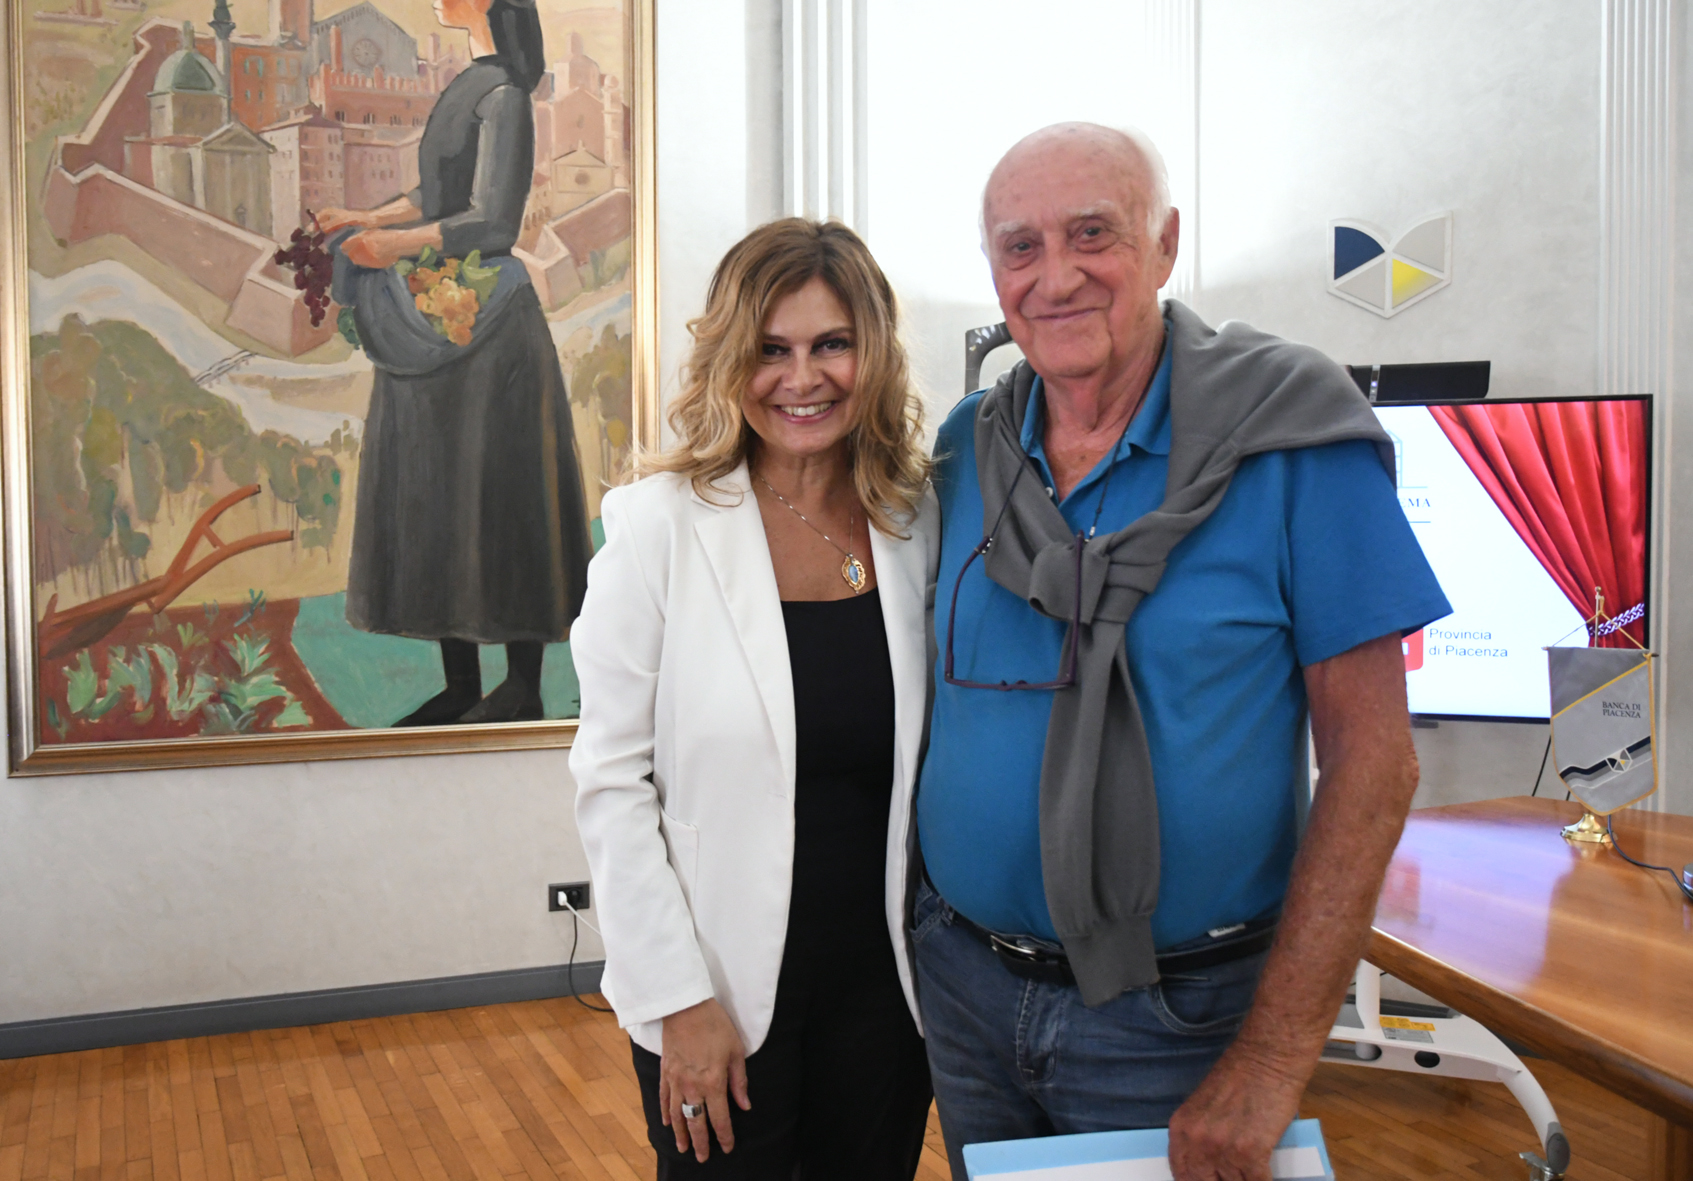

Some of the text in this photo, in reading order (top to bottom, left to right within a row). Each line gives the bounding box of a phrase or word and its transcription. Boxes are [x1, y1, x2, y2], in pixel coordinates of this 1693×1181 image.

[1429, 628, 1492, 640] Provincia
[1428, 645, 1508, 657] di Piacenza
[1602, 701, 1641, 711] BANCA DI
[1602, 709, 1641, 718] PIACENZA
